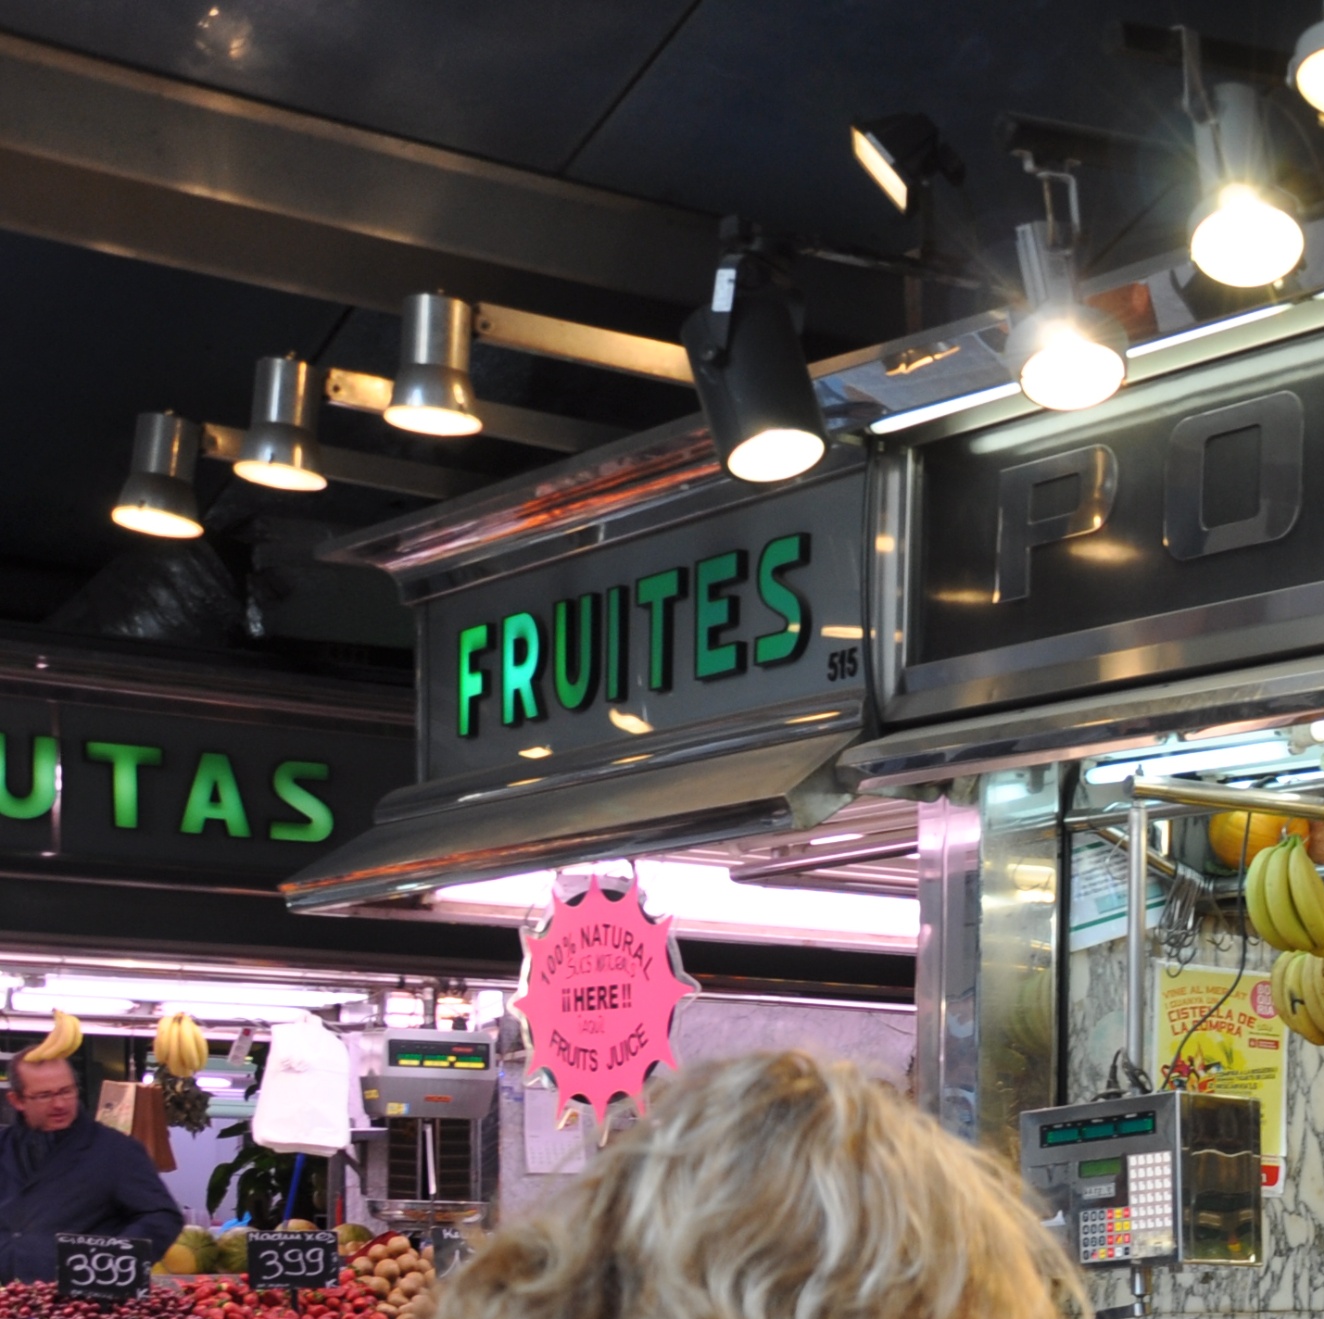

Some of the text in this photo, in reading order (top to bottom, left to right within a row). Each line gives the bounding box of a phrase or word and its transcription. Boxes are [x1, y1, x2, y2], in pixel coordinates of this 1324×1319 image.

[457, 532, 810, 738] FRUITES
[827, 647, 858, 682] 515
[581, 924, 653, 982] NATURAL
[1171, 1023, 1190, 1037] LA
[1238, 1012, 1257, 1029] DE
[549, 1022, 649, 1072] FRUITS JUICE
